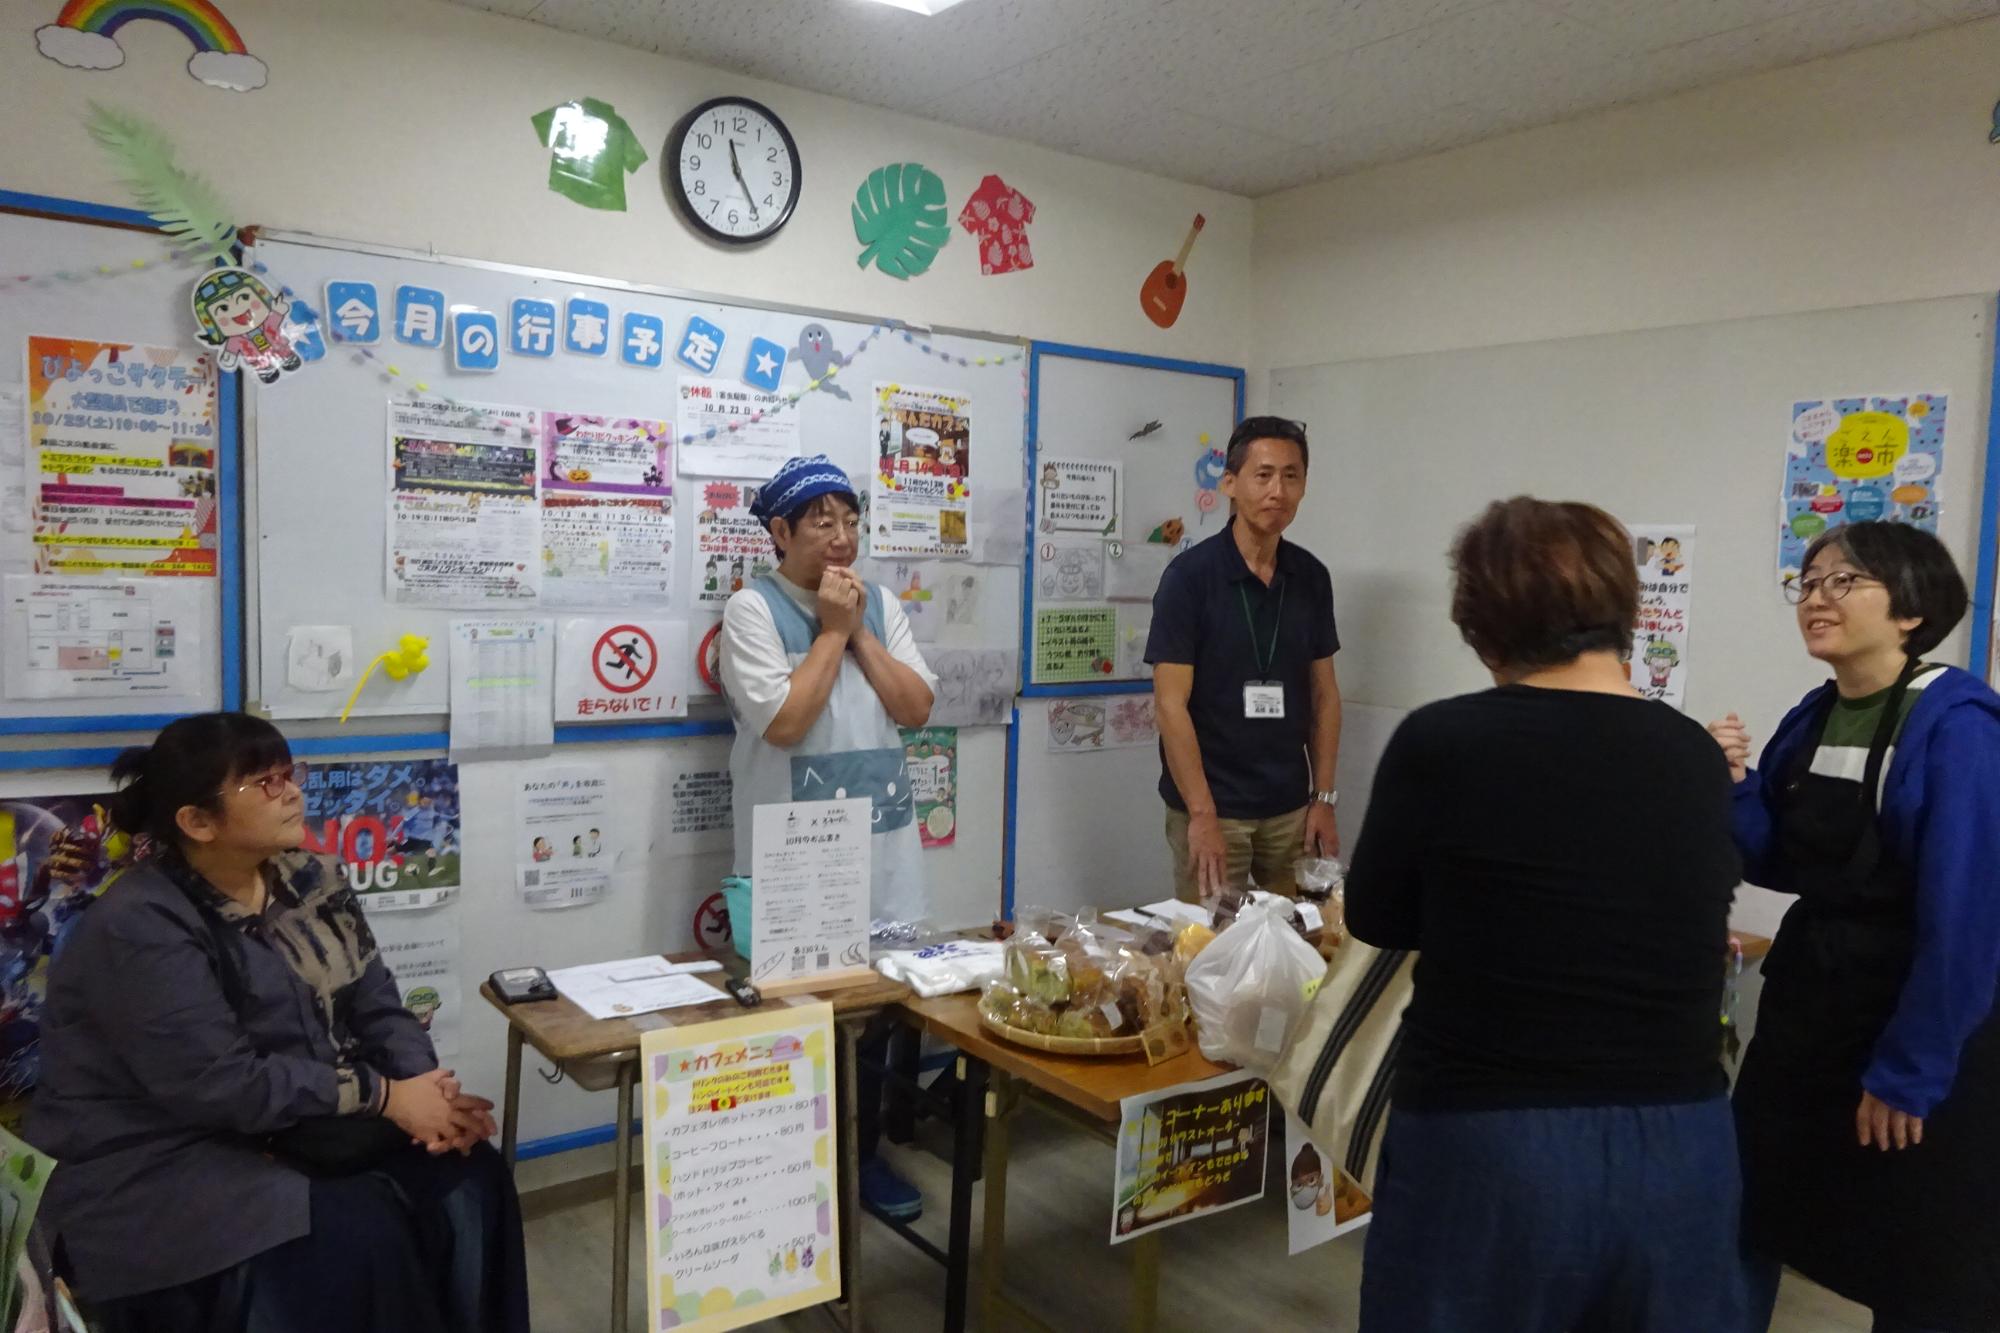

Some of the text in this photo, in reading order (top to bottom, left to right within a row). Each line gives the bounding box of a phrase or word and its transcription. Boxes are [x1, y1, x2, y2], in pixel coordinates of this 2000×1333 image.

[714, 119, 725, 135] 11
[732, 116, 748, 134] 12
[696, 132, 712, 150] 10
[756, 128, 761, 142] 1
[689, 155, 701, 171] 9
[766, 147, 777, 163] 2
[772, 171, 782, 187] 3
[694, 180, 706, 196] 8
[710, 199, 720, 215] 7
[763, 194, 773, 208] 4
[728, 209, 738, 224] 6
[750, 206, 760, 222] 5
[302, 763, 426, 790] 乱用はダメ。
[341, 860, 398, 891] UG
